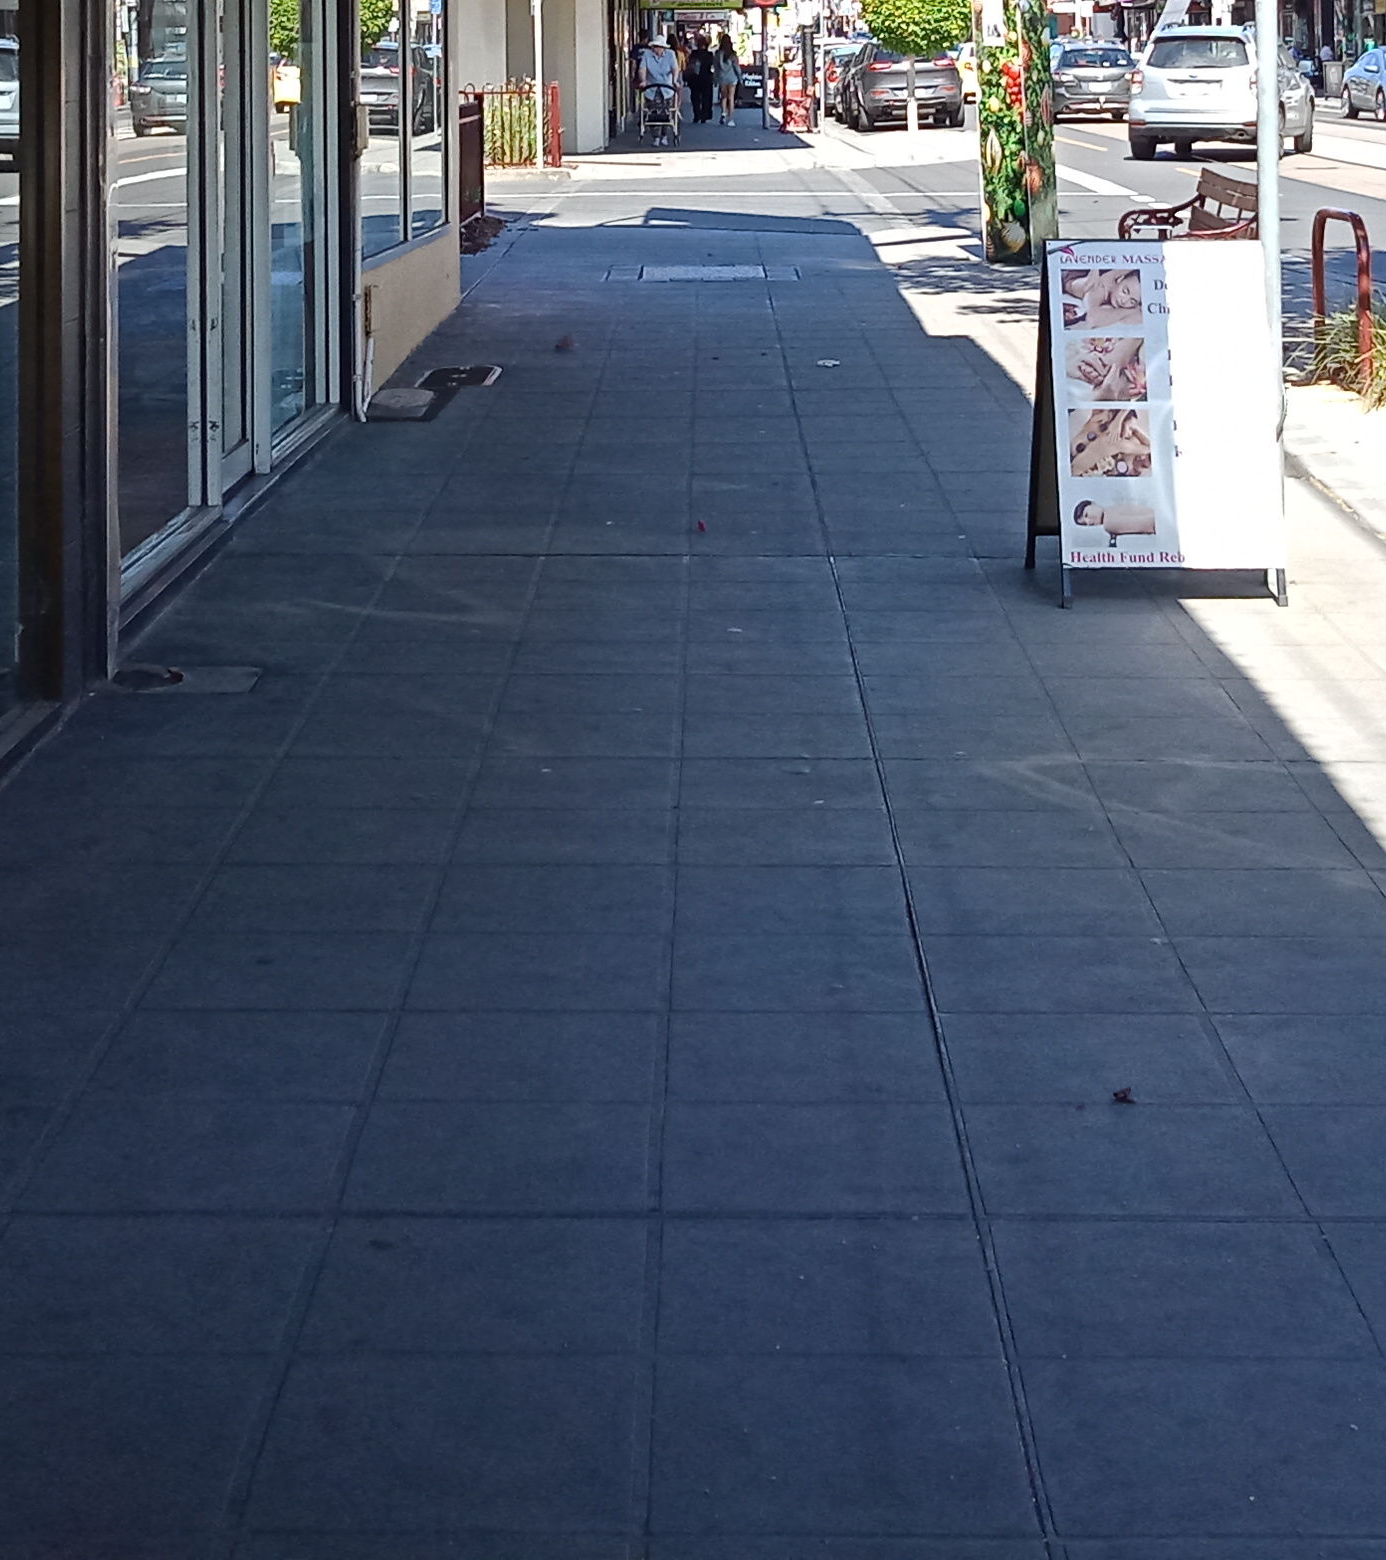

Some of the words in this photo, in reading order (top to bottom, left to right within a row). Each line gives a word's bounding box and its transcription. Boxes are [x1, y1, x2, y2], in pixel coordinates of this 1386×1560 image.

[1059, 253, 1116, 265] LAVENDER
[1122, 255, 1167, 265] MASSA
[1070, 551, 1115, 564] Health
[1120, 551, 1155, 564] Fund
[1159, 551, 1186, 564] Reb
